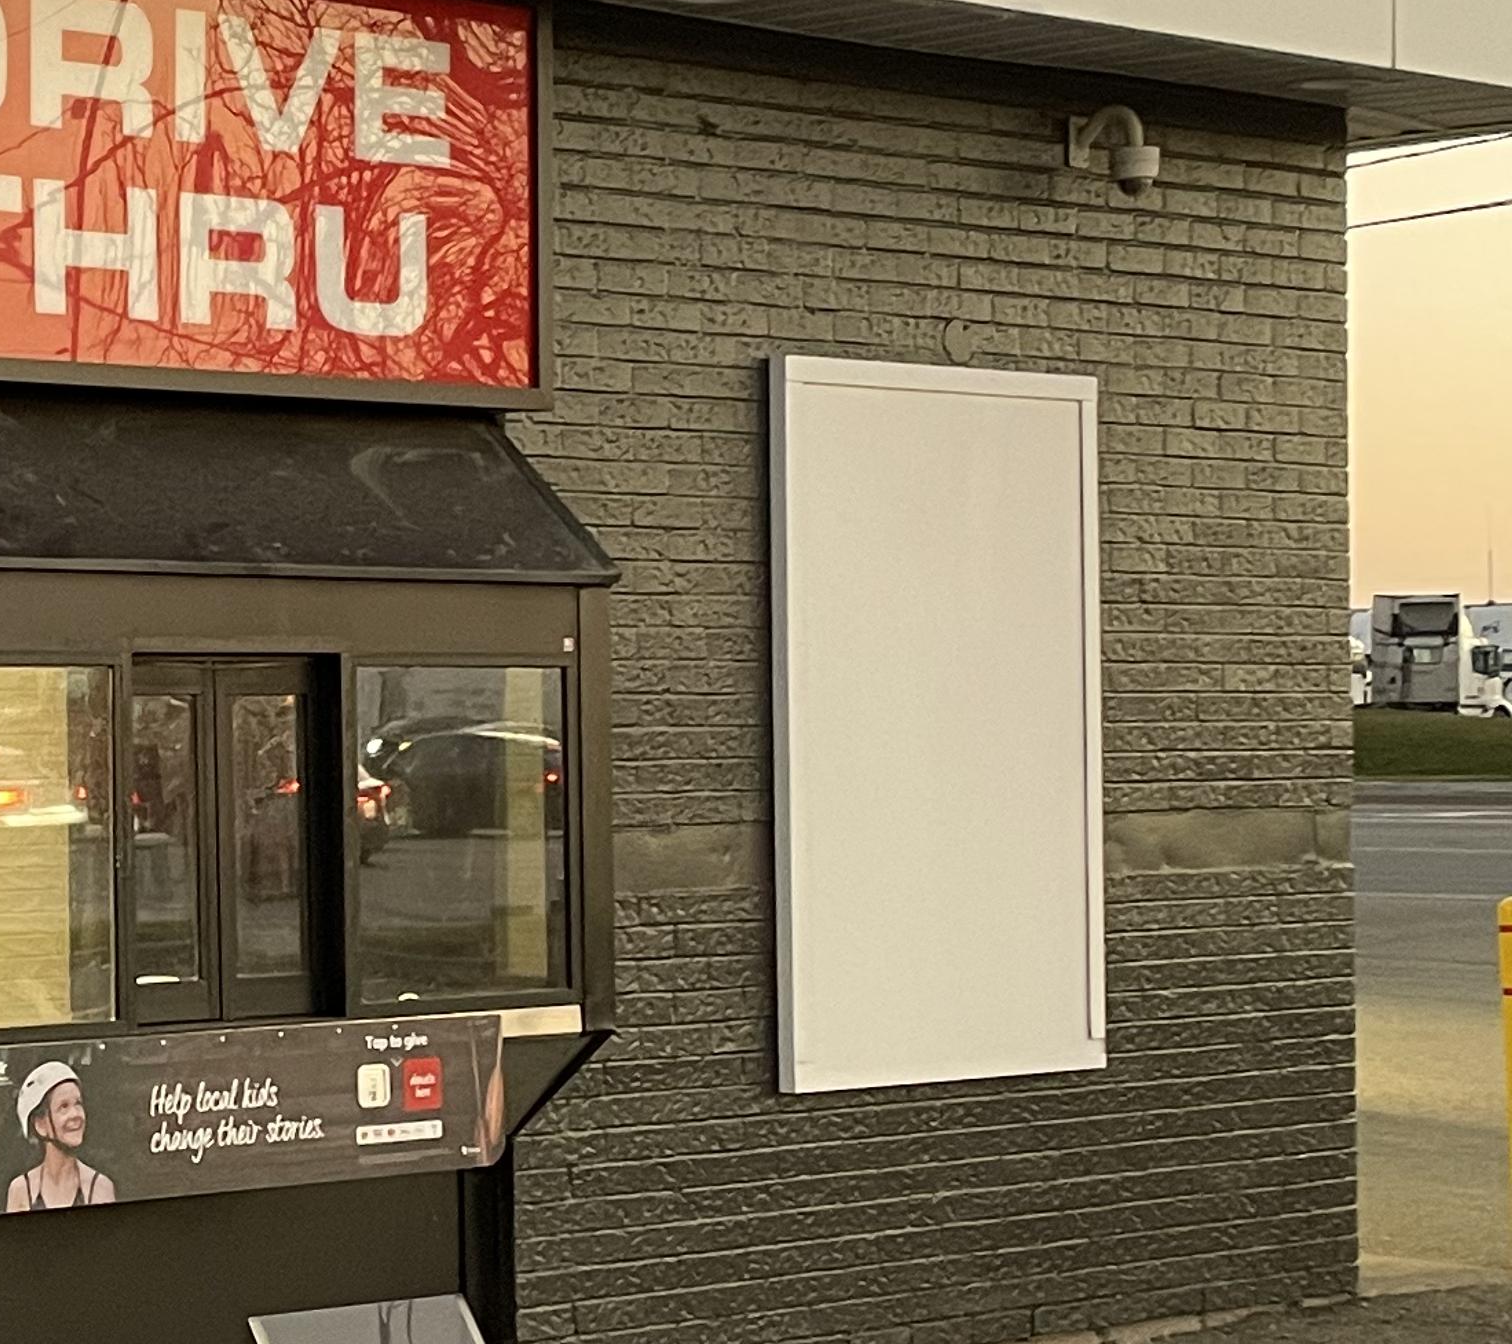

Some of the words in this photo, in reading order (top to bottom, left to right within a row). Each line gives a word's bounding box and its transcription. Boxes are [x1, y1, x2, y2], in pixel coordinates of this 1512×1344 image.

[364, 1035, 389, 1052] Tap
[389, 1034, 403, 1049] to
[403, 1032, 430, 1051] give
[149, 1082, 193, 1125] Help
[195, 1078, 239, 1113] local
[241, 1077, 279, 1109] kids
[150, 1120, 215, 1164] change
[217, 1115, 263, 1147] their
